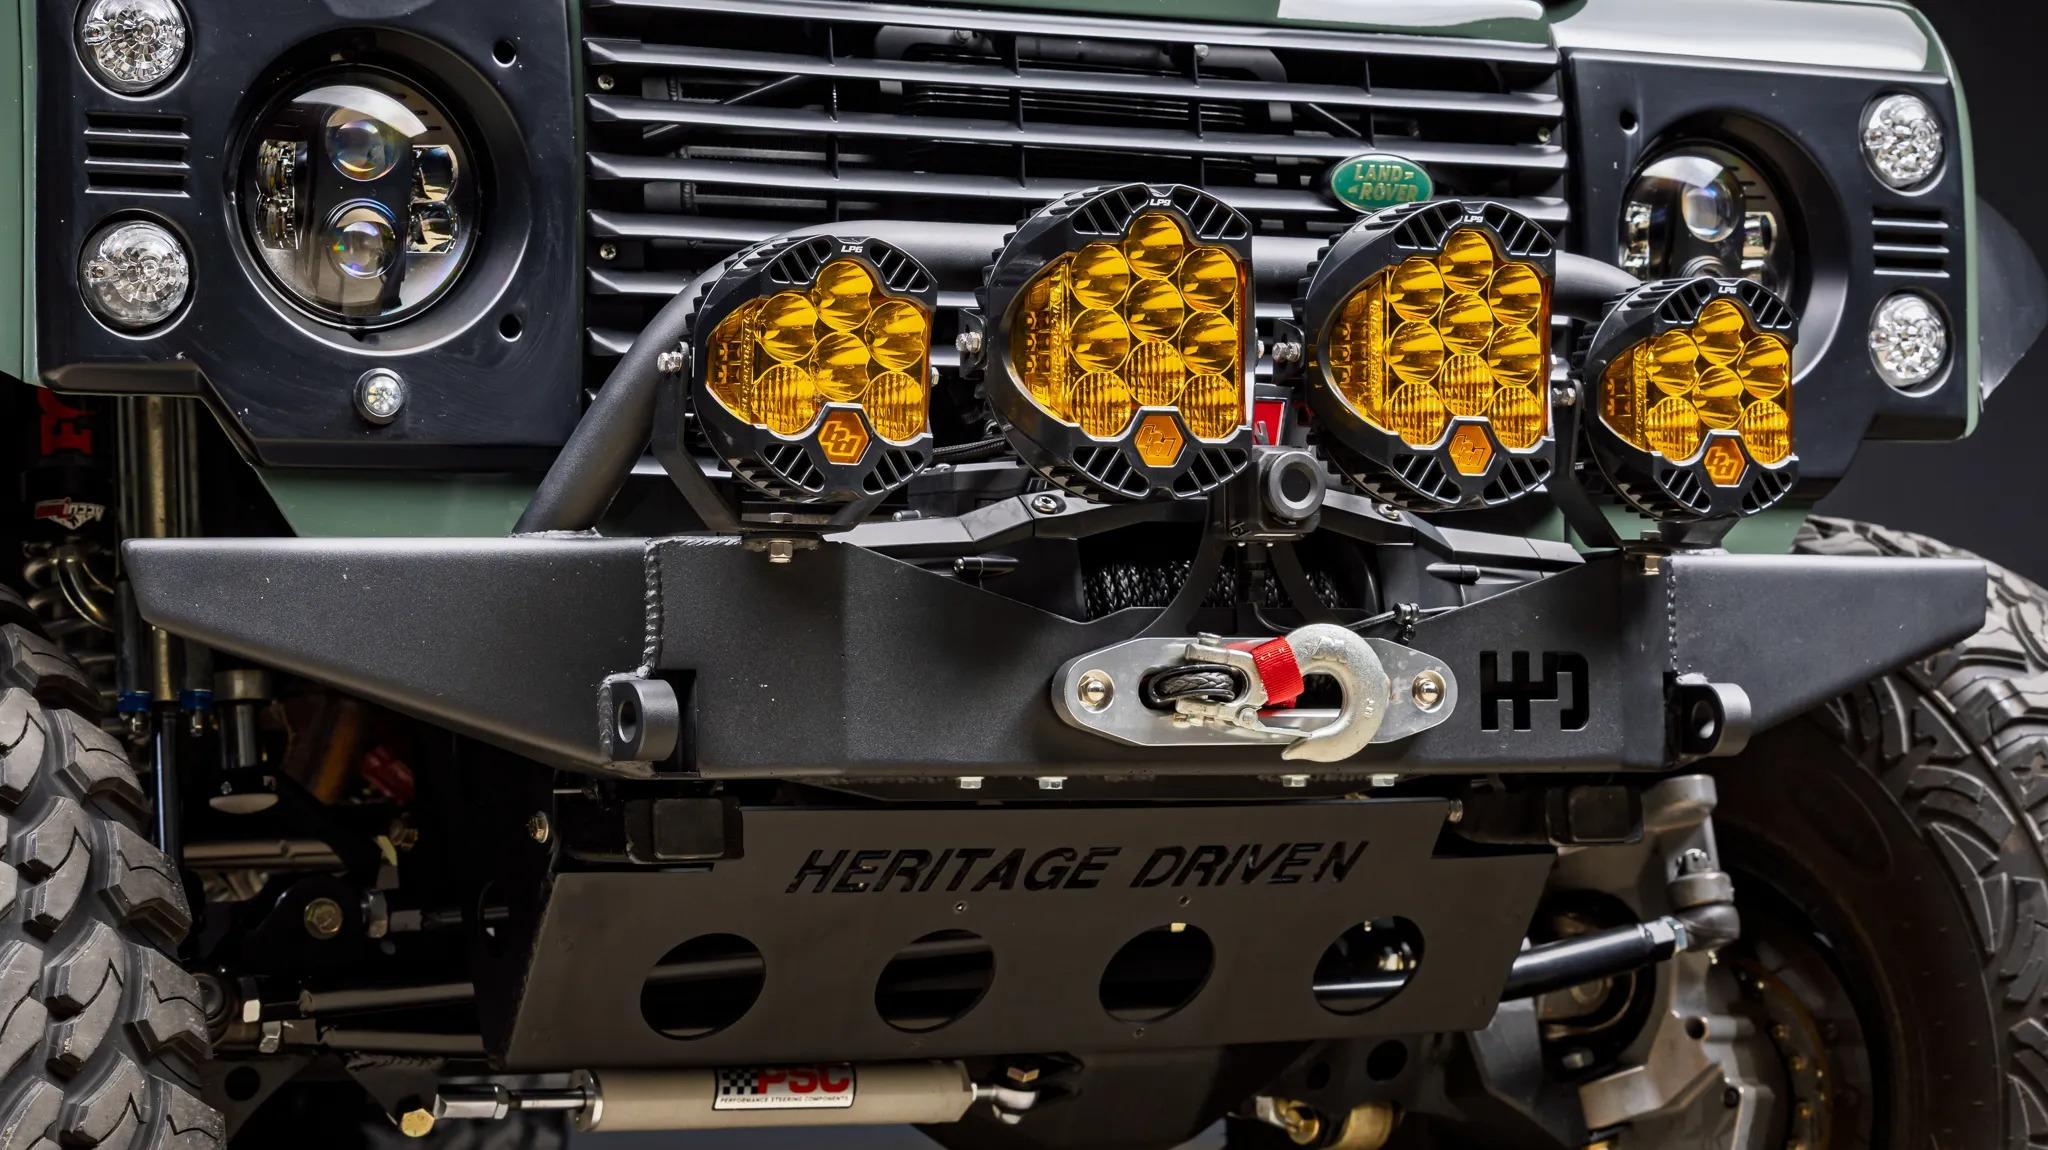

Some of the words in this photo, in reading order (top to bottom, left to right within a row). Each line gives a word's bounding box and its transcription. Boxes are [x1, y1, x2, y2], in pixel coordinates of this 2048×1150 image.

[1354, 163, 1403, 181] LAND
[1358, 181, 1419, 203] ROVER
[1149, 198, 1172, 207] LP9
[1463, 214, 1484, 223] LP9
[840, 244, 864, 253] LP6
[785, 846, 1122, 894] HERITAGE
[1129, 841, 1370, 888] DRIVEN
[758, 1064, 850, 1095] PSC
[720, 1096, 769, 1104] PERFORMANCE
